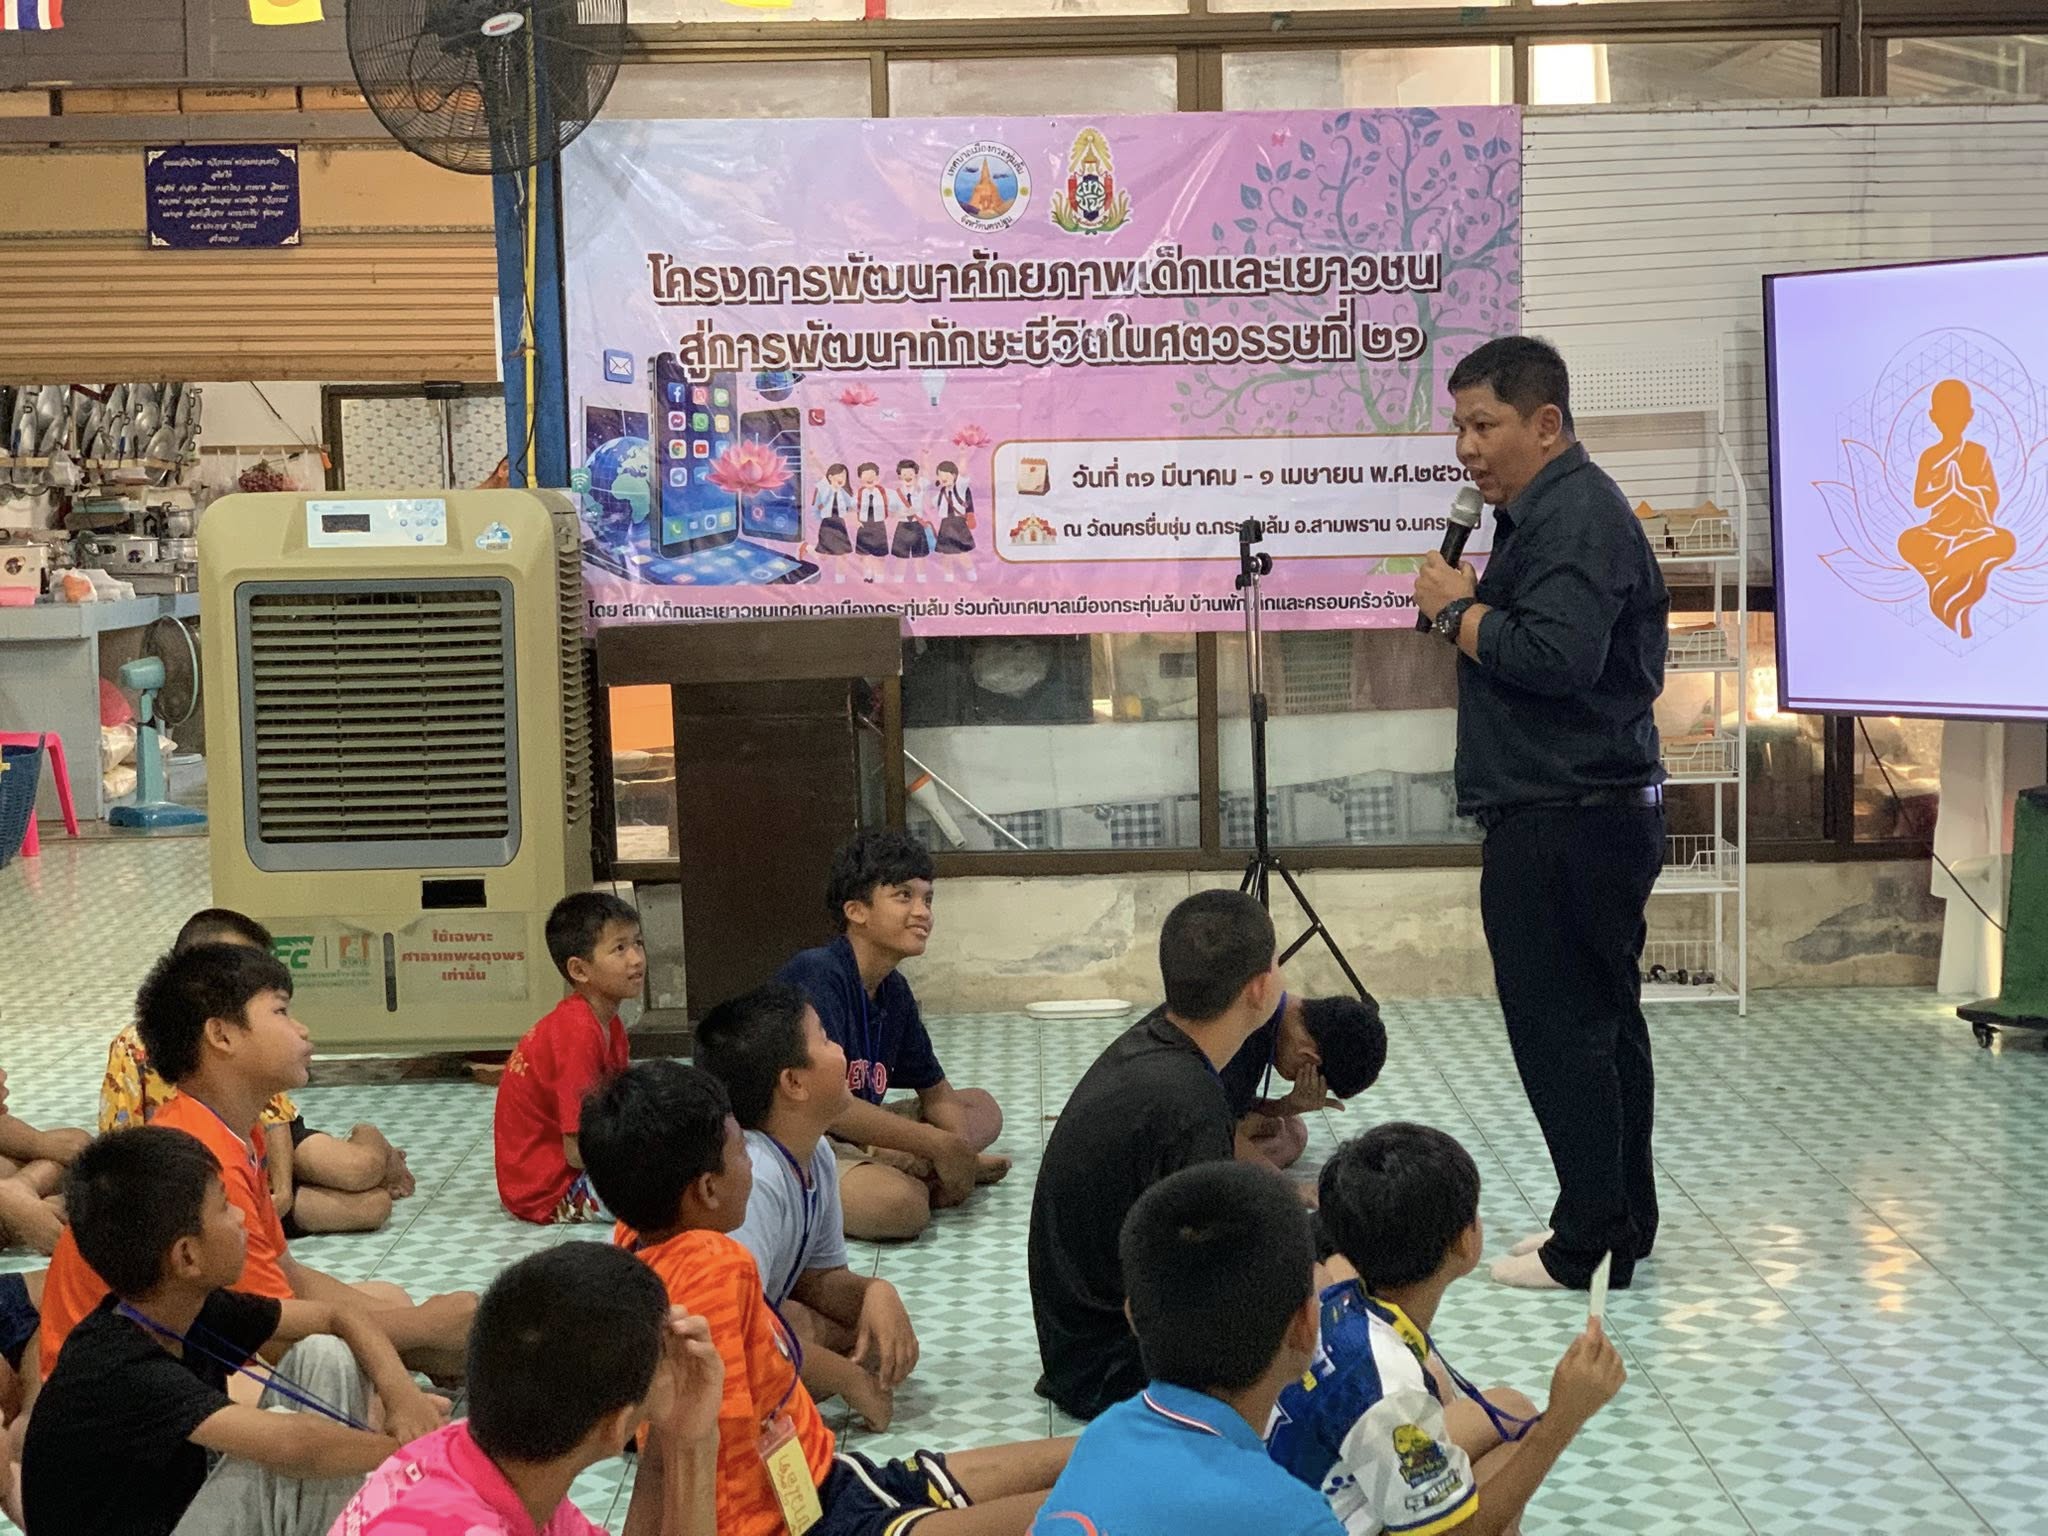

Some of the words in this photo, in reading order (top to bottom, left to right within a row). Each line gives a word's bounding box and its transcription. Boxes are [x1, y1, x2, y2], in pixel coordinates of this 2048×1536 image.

[647, 245, 1442, 304] โครงการพัฒนาศักยภาพเด็กและเยาวชน
[1072, 457, 1119, 488] วันที่
[1126, 472, 1155, 487] ๓๑
[1161, 462, 1237, 487] มีนาคม
[1260, 470, 1274, 486] ๑
[1281, 465, 1364, 485] เมษายน
[1063, 523, 1082, 537] ณ
[1087, 512, 1191, 541] วัดนครชื่นชุ่ม
[1294, 517, 1391, 533] อ.สามพราน
[587, 599, 617, 618] โดย
[954, 594, 1185, 617] ร่วมกับเทศบาลเมืองกระทุ่มล้ม
[432, 929, 493, 942] ใช้เฉพาะ
[402, 951, 525, 965] ศาลาเทพผดุงพร
[442, 964, 486, 981] เท่านั้น
